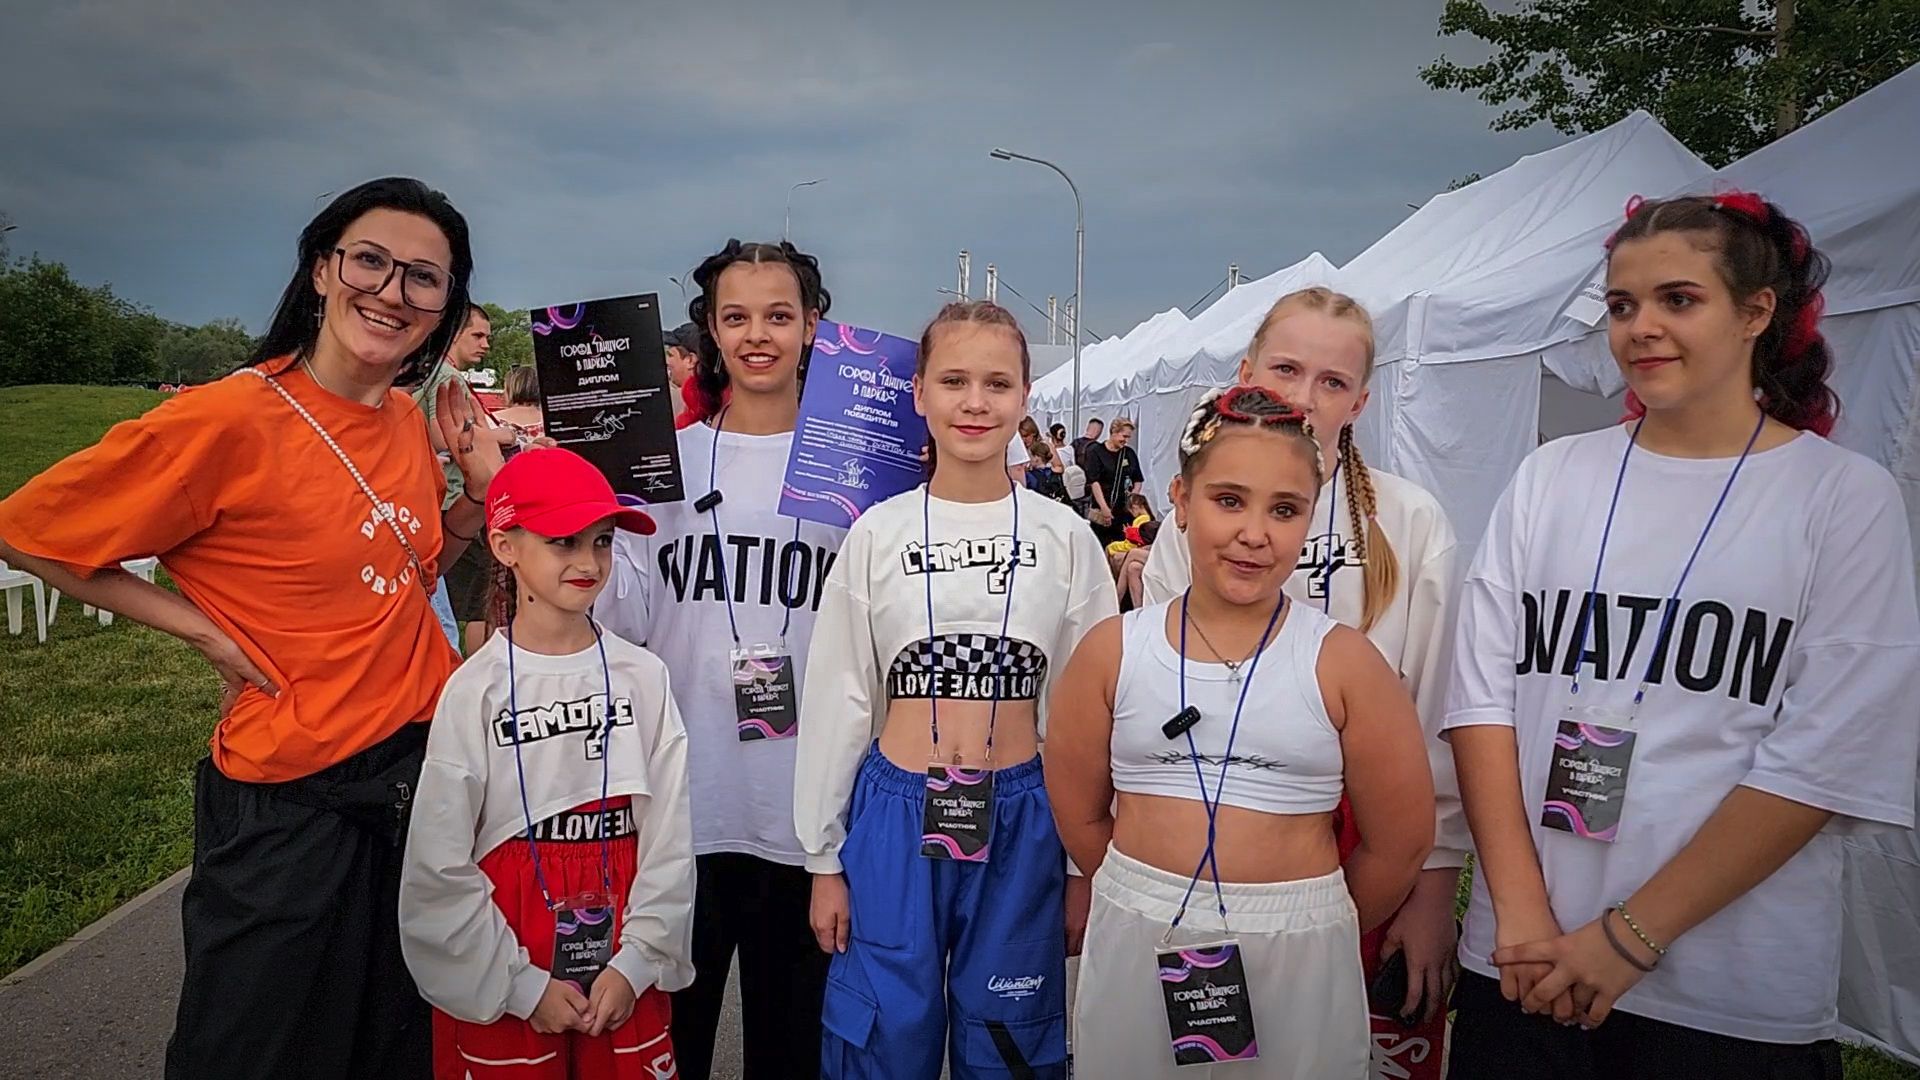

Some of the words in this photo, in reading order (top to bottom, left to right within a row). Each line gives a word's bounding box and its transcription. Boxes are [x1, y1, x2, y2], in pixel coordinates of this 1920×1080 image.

[560, 342, 592, 358] ГОРОД
[576, 360, 582, 371] В
[578, 373, 619, 386] ДИПЛОМ
[838, 364, 876, 385] ГОРОД
[879, 370, 914, 393] ТАНЦУЕ
[853, 383, 859, 395] В
[843, 409, 899, 428] ПОБЕДИТЕЛЯ
[853, 404, 892, 419] ДИПЛОМ
[361, 503, 421, 540] DANCE
[897, 673, 943, 696] LOVE
[551, 813, 611, 840] LOVE
